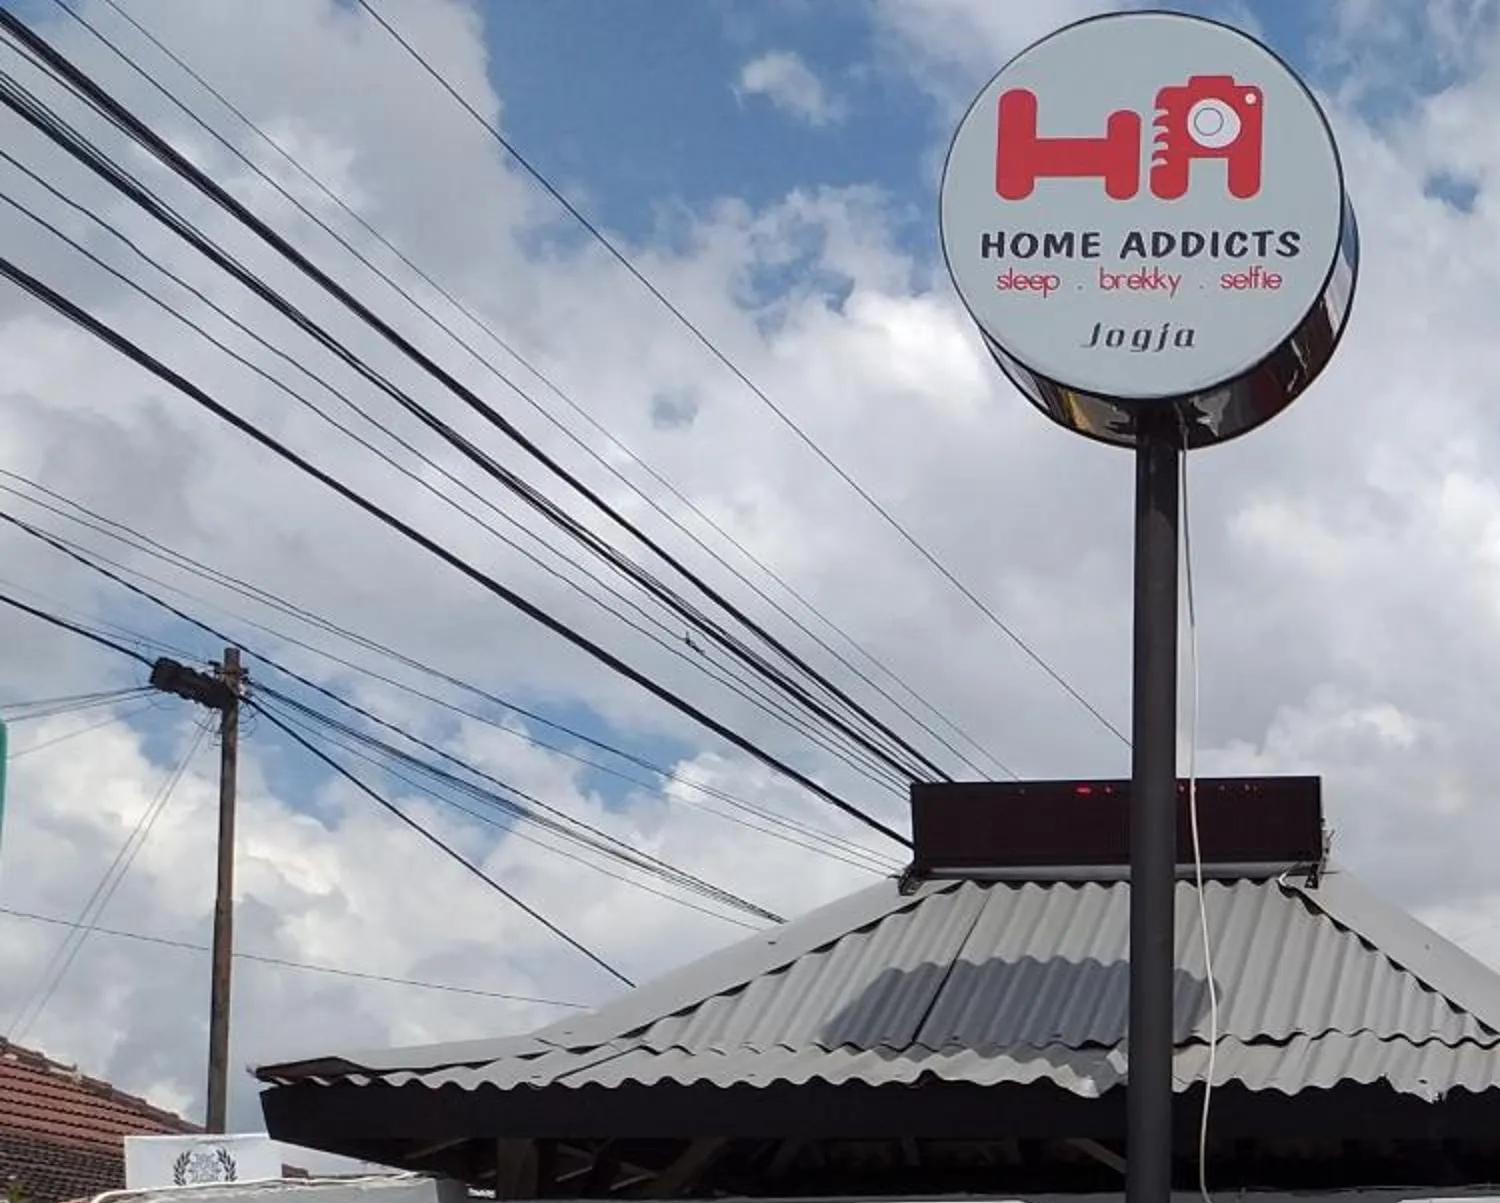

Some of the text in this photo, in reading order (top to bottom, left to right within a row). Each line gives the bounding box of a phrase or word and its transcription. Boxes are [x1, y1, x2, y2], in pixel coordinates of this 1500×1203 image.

[981, 230, 1301, 259] HOME ADDICTS
[997, 266, 1283, 298] sleep brekky selfie
[1081, 322, 1195, 353] Jogja
